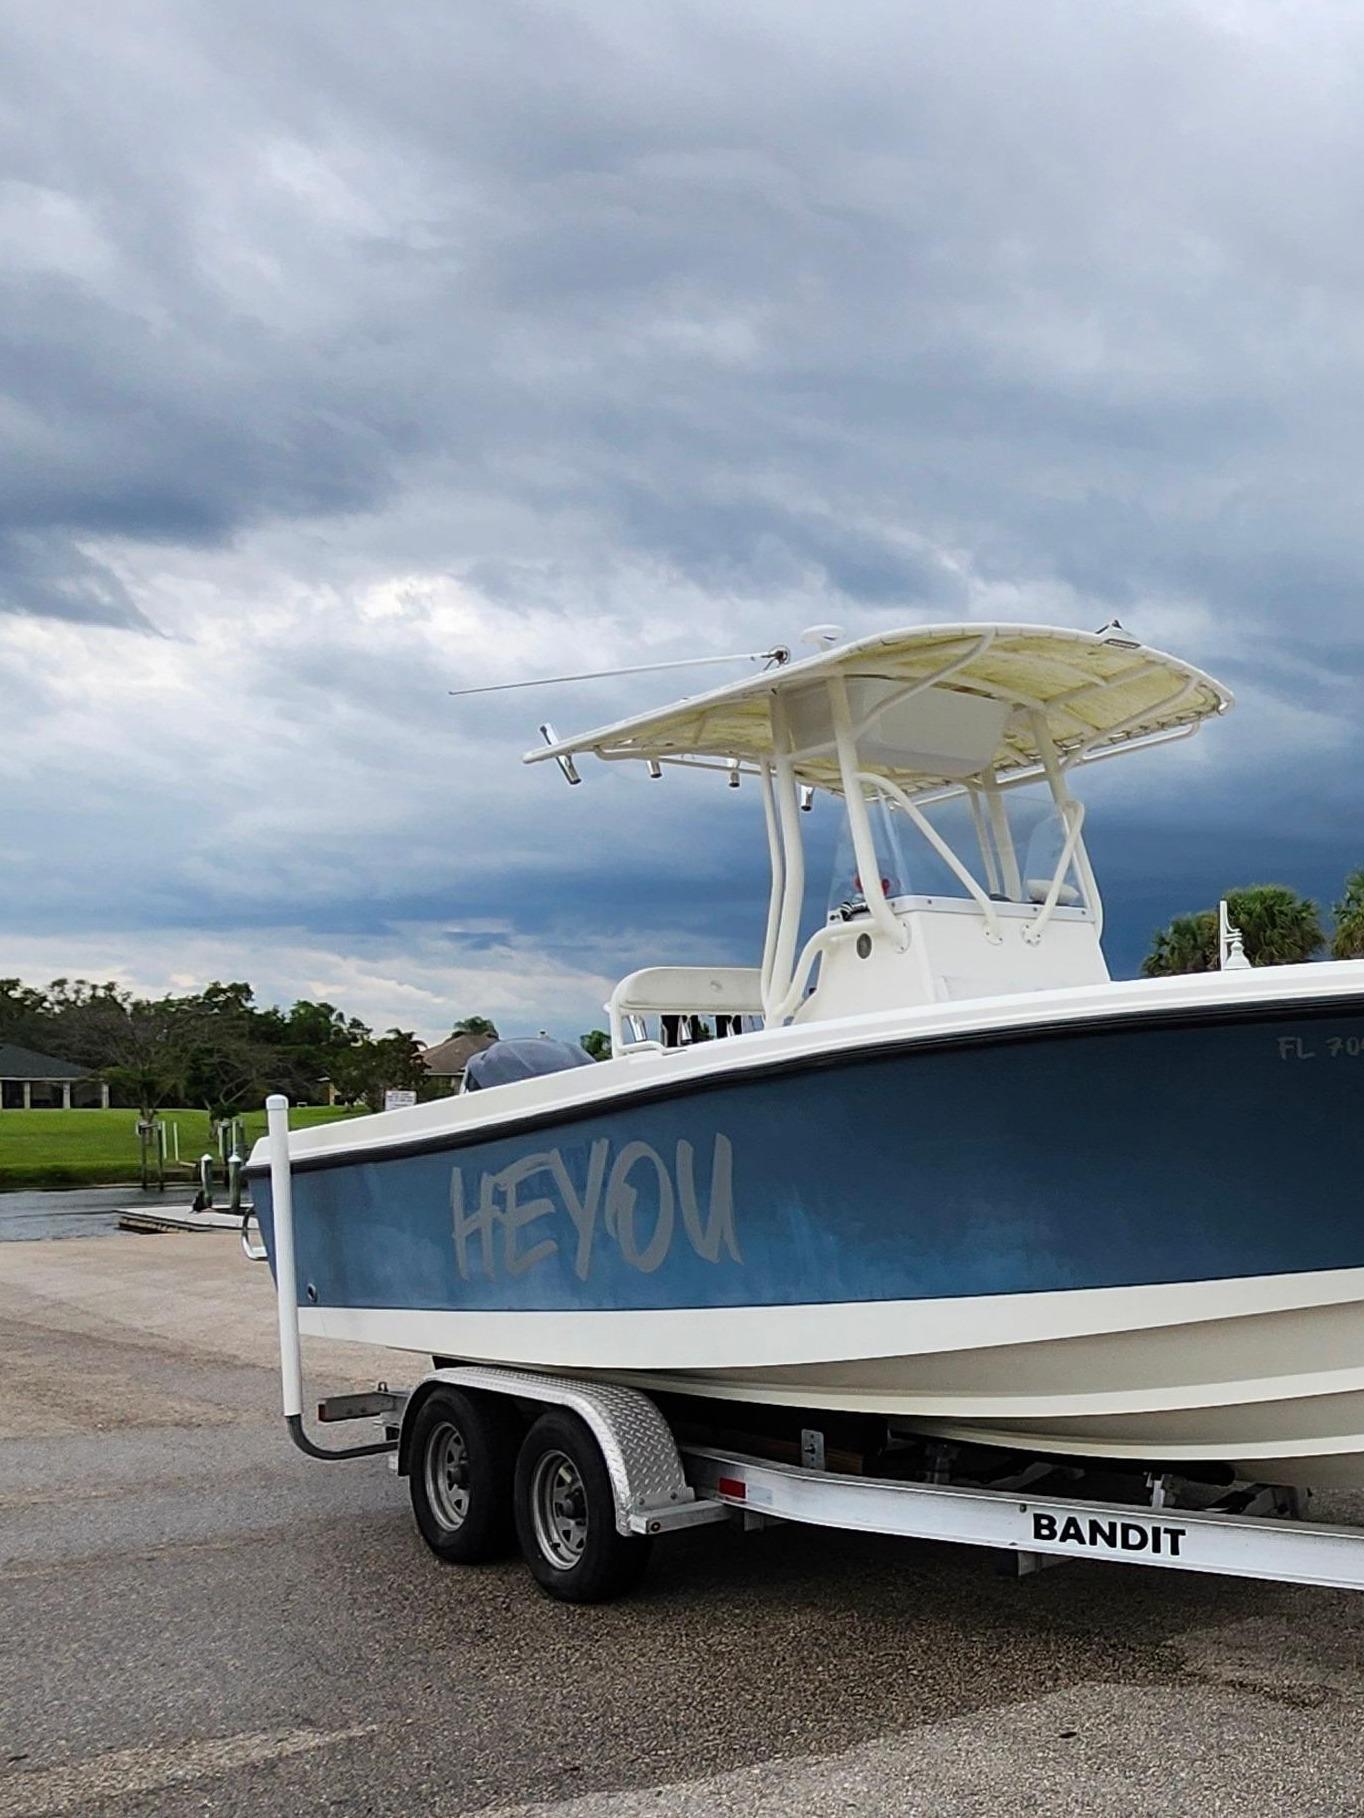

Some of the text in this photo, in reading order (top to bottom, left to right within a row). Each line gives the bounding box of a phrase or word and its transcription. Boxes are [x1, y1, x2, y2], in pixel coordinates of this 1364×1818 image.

[1277, 1036, 1316, 1060] FL
[451, 1132, 744, 1281] HEYOU
[1033, 1513, 1186, 1556] BANDIT
